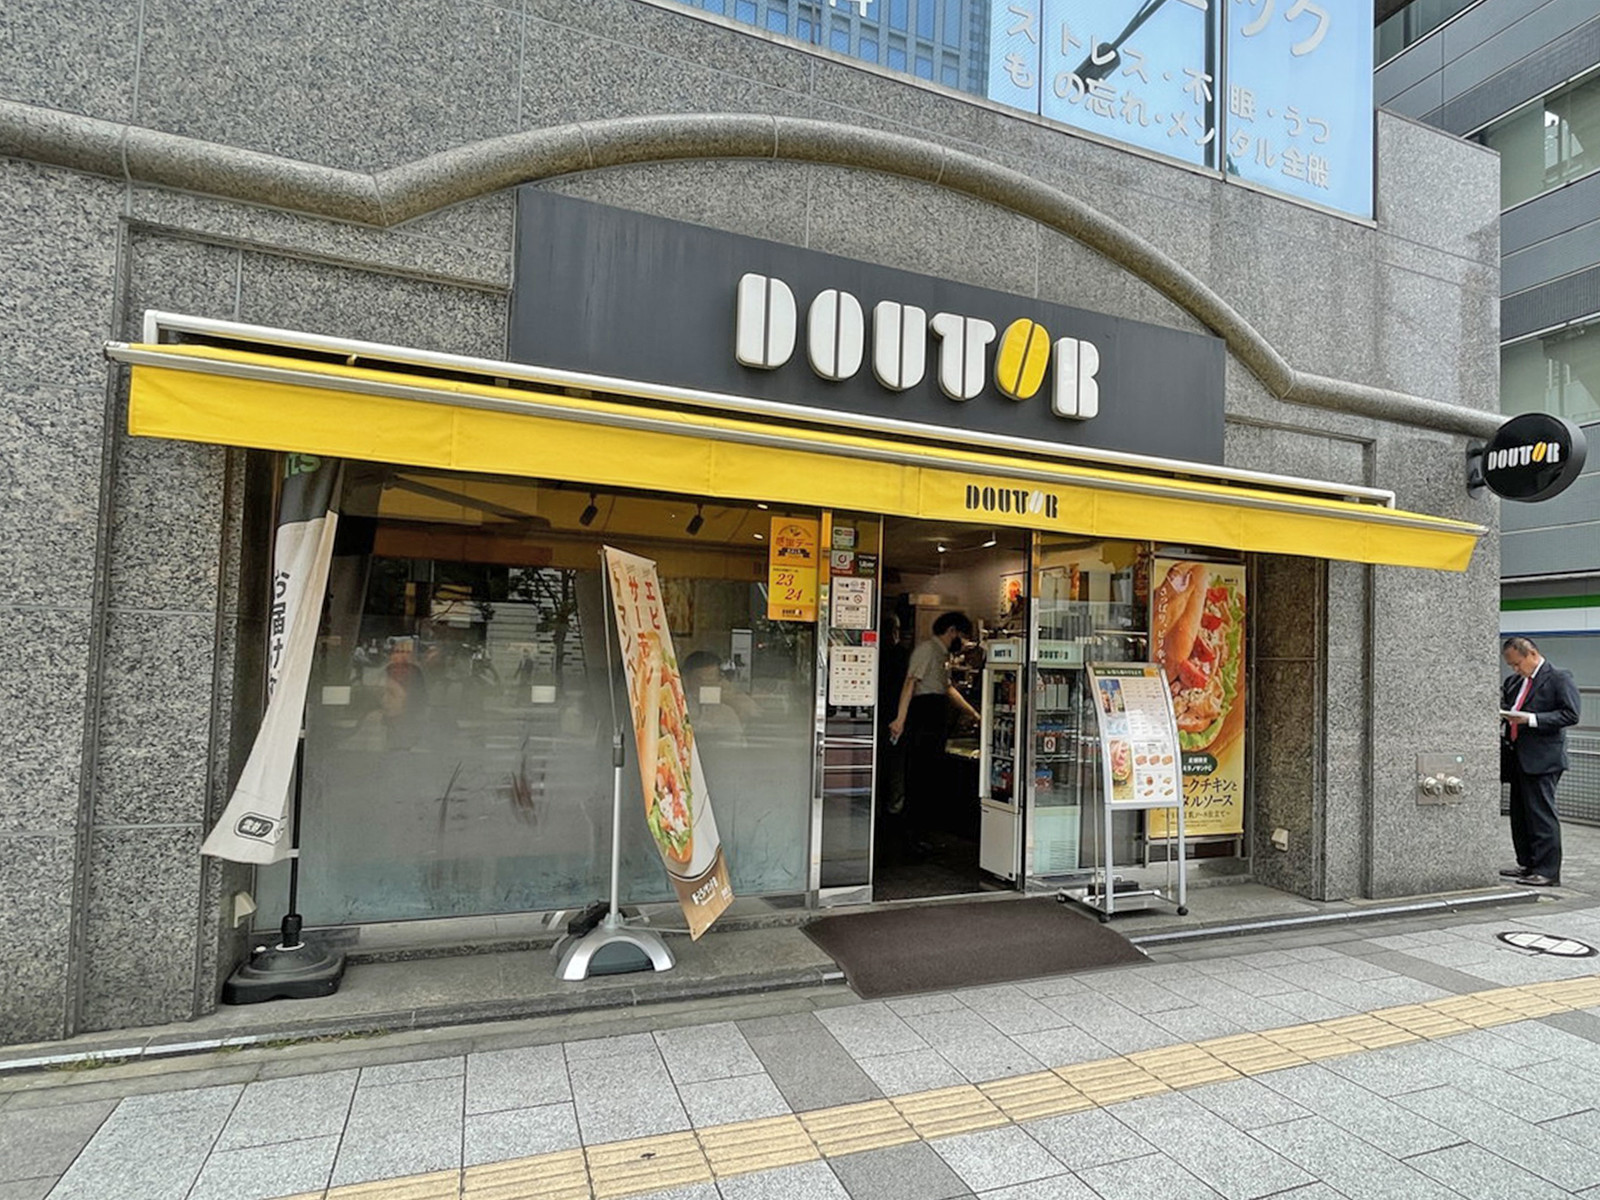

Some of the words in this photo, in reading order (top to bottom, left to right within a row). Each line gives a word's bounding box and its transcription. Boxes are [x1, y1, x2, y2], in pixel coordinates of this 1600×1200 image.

[735, 271, 1101, 421] DOUTOR
[1487, 440, 1561, 472] DOUTOR
[965, 484, 1059, 519] DOUTOR
[775, 572, 795, 587] 23
